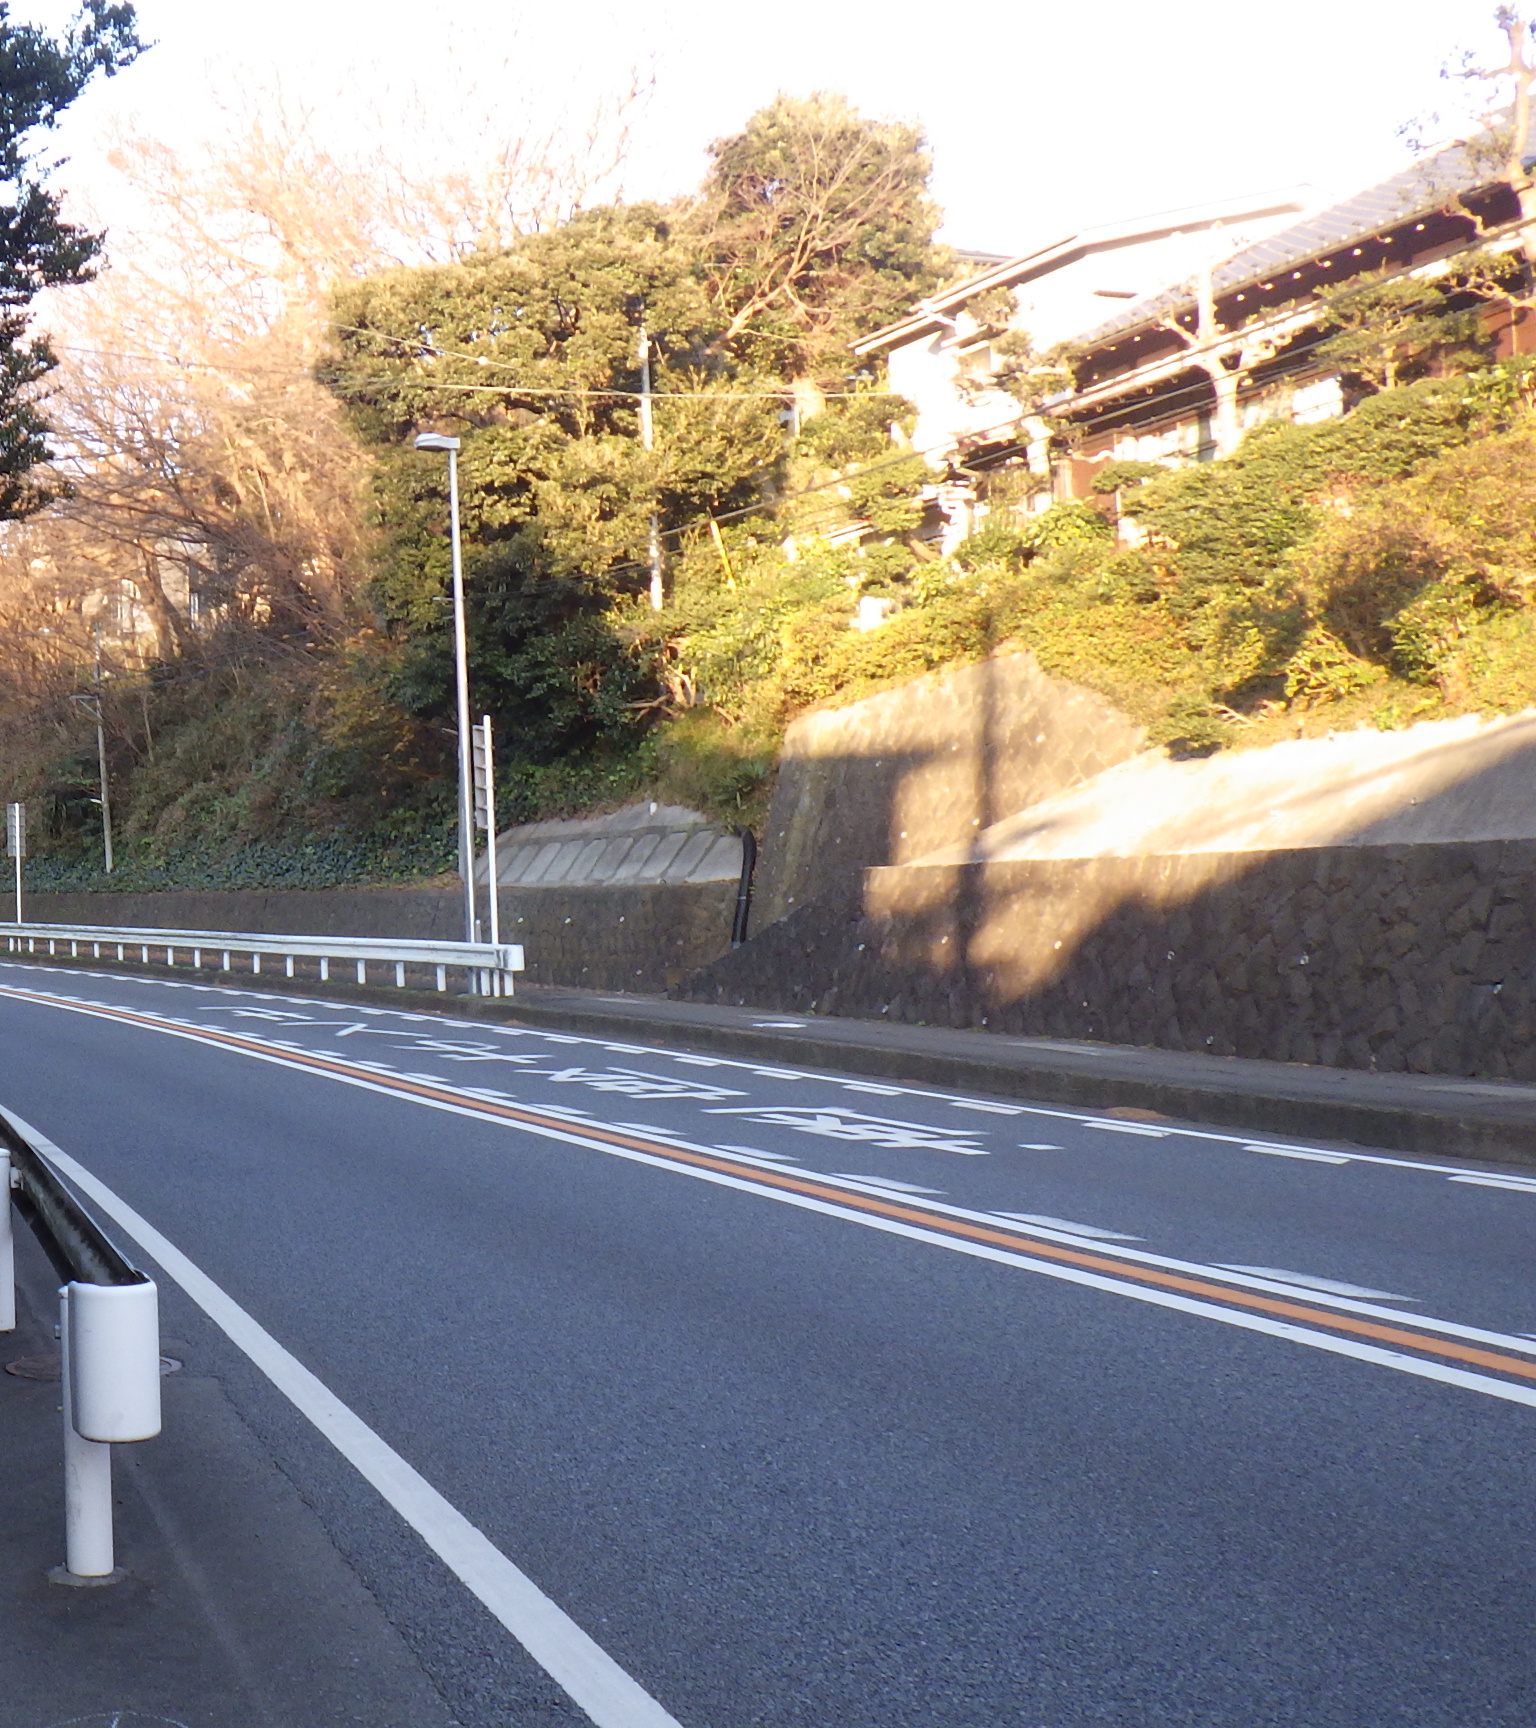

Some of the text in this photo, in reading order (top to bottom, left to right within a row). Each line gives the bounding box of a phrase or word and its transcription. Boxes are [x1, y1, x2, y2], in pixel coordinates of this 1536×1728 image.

[199, 1005, 1064, 1155] 速度おとせ
